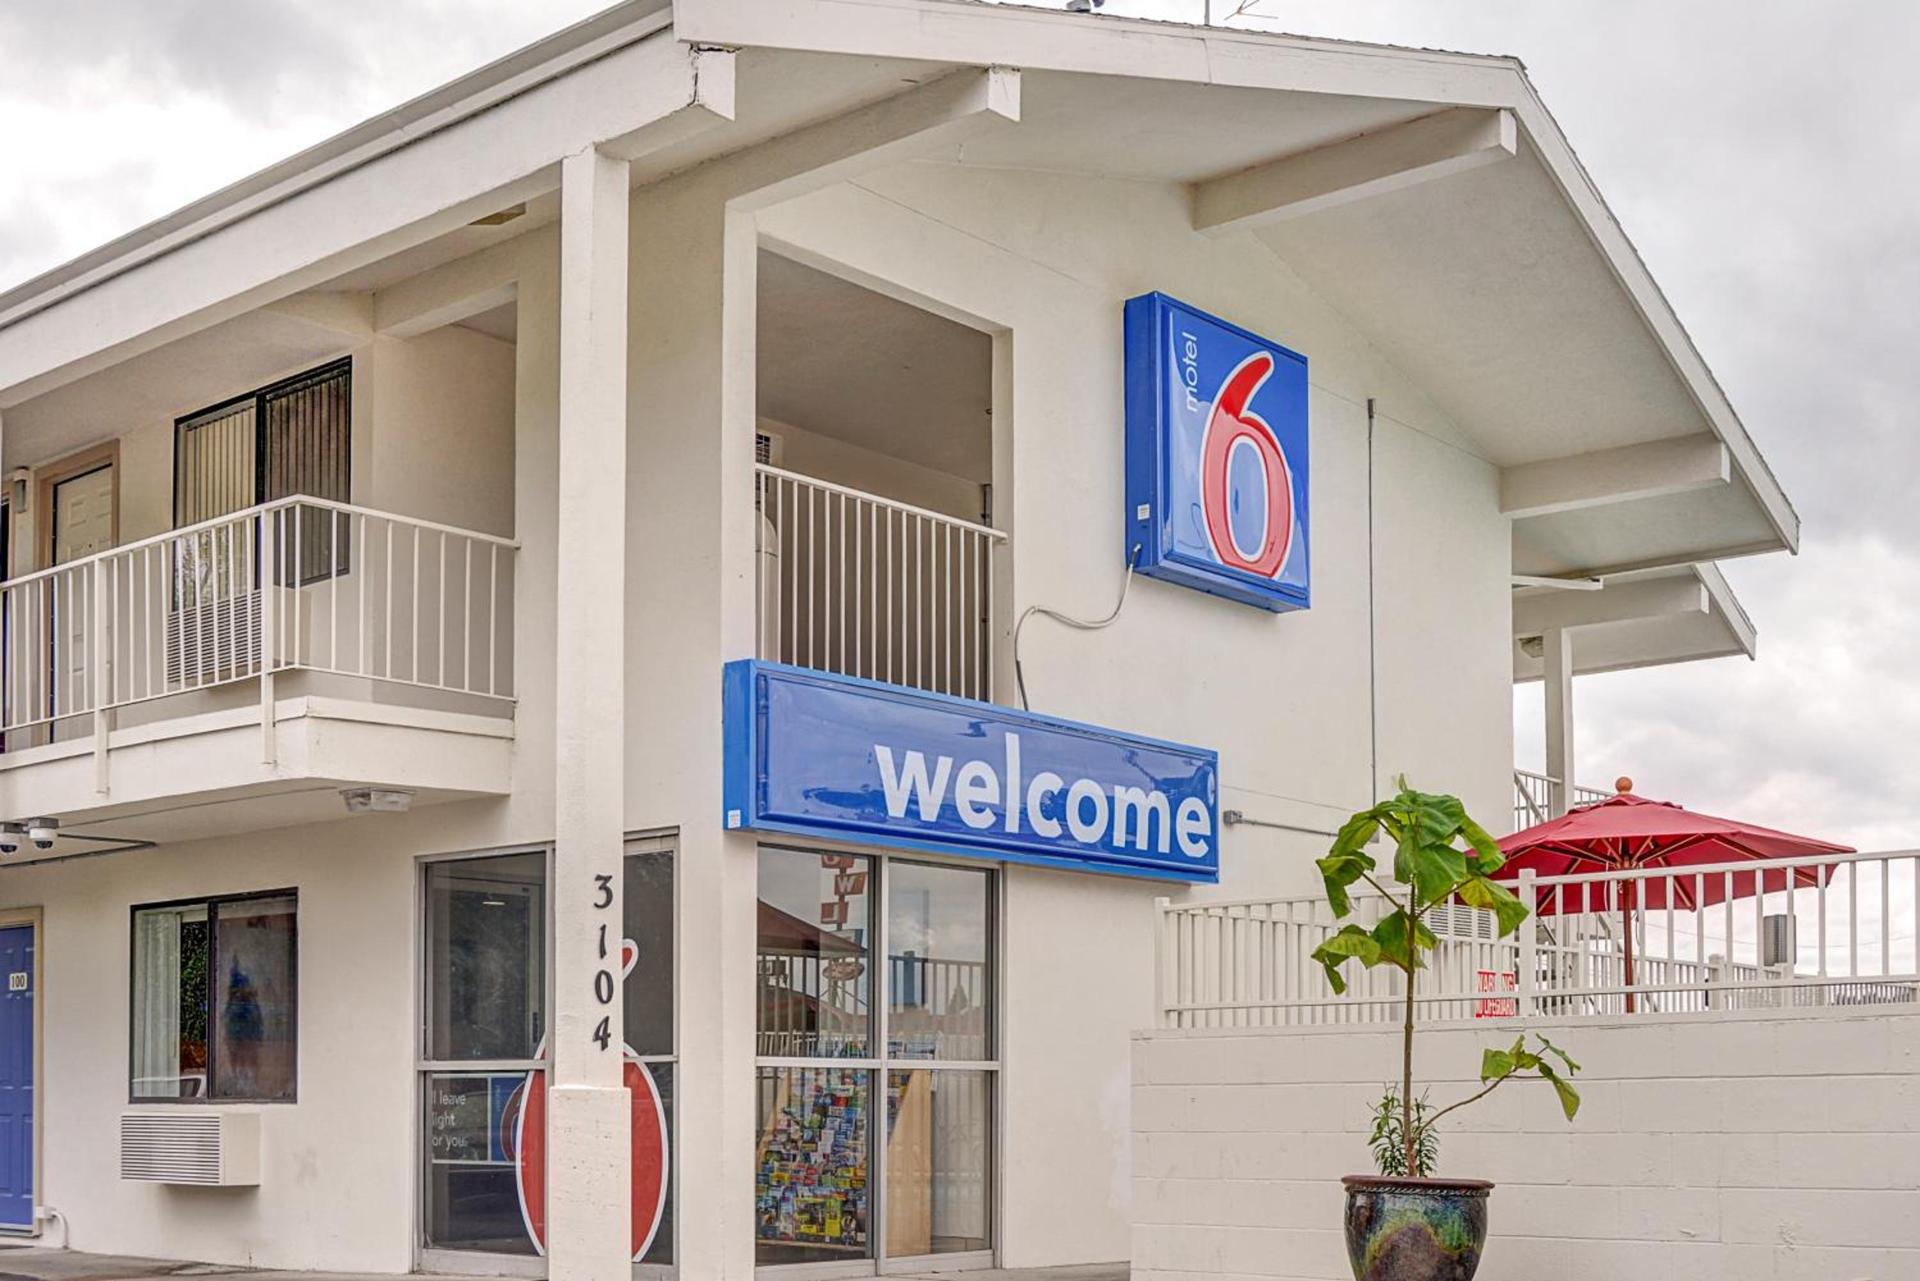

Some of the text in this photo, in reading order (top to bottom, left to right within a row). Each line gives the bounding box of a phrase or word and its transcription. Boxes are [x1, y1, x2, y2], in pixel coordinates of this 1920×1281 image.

[1182, 332, 1198, 412] motel
[1199, 351, 1294, 580] 6
[874, 732, 1212, 858] welcome
[12, 975, 25, 988] 100
[592, 874, 614, 1051] 3104
[440, 1090, 466, 1106] leave
